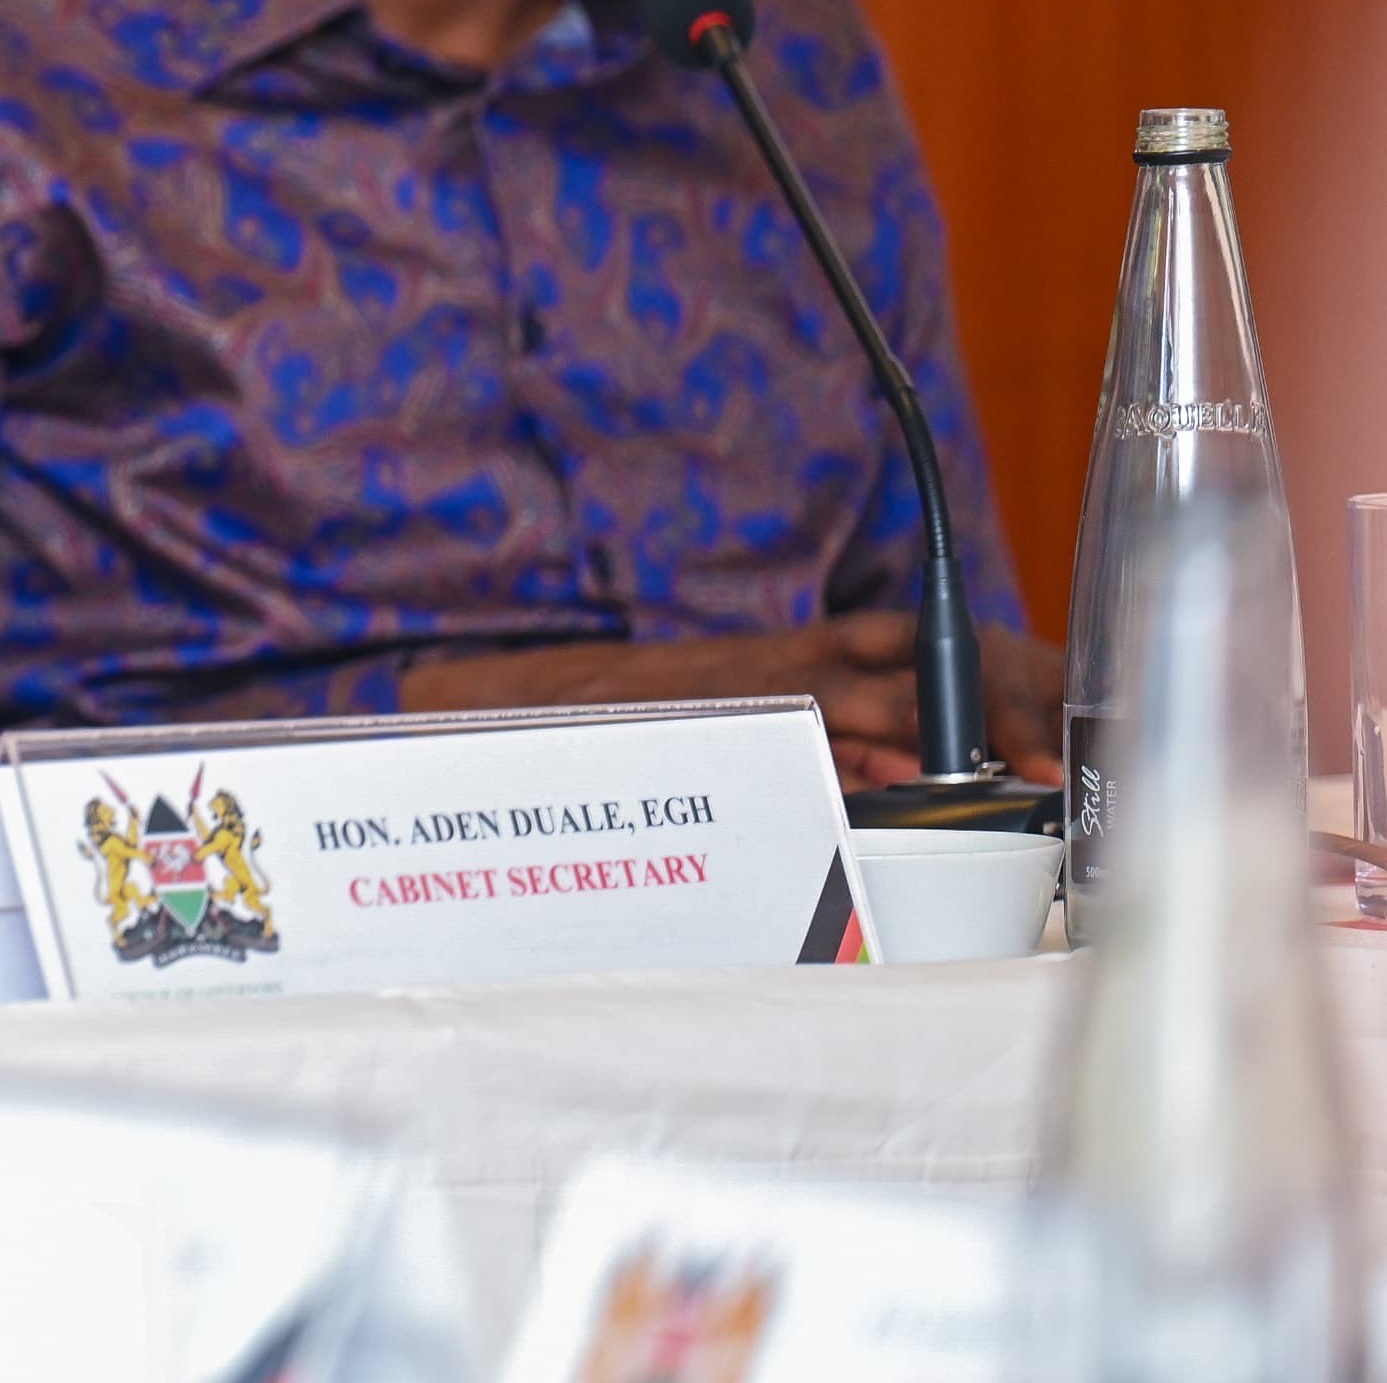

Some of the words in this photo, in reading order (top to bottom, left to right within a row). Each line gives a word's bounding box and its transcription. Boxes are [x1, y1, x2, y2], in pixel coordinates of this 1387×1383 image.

[314, 816, 401, 851] HON.
[410, 809, 502, 845] ADEN
[508, 800, 636, 837] DUALE,
[641, 795, 716, 829] EGH
[1081, 765, 1104, 838] Still
[1106, 779, 1116, 830] WATER
[349, 867, 498, 909] CABINET
[506, 853, 709, 897] SECRETARY
